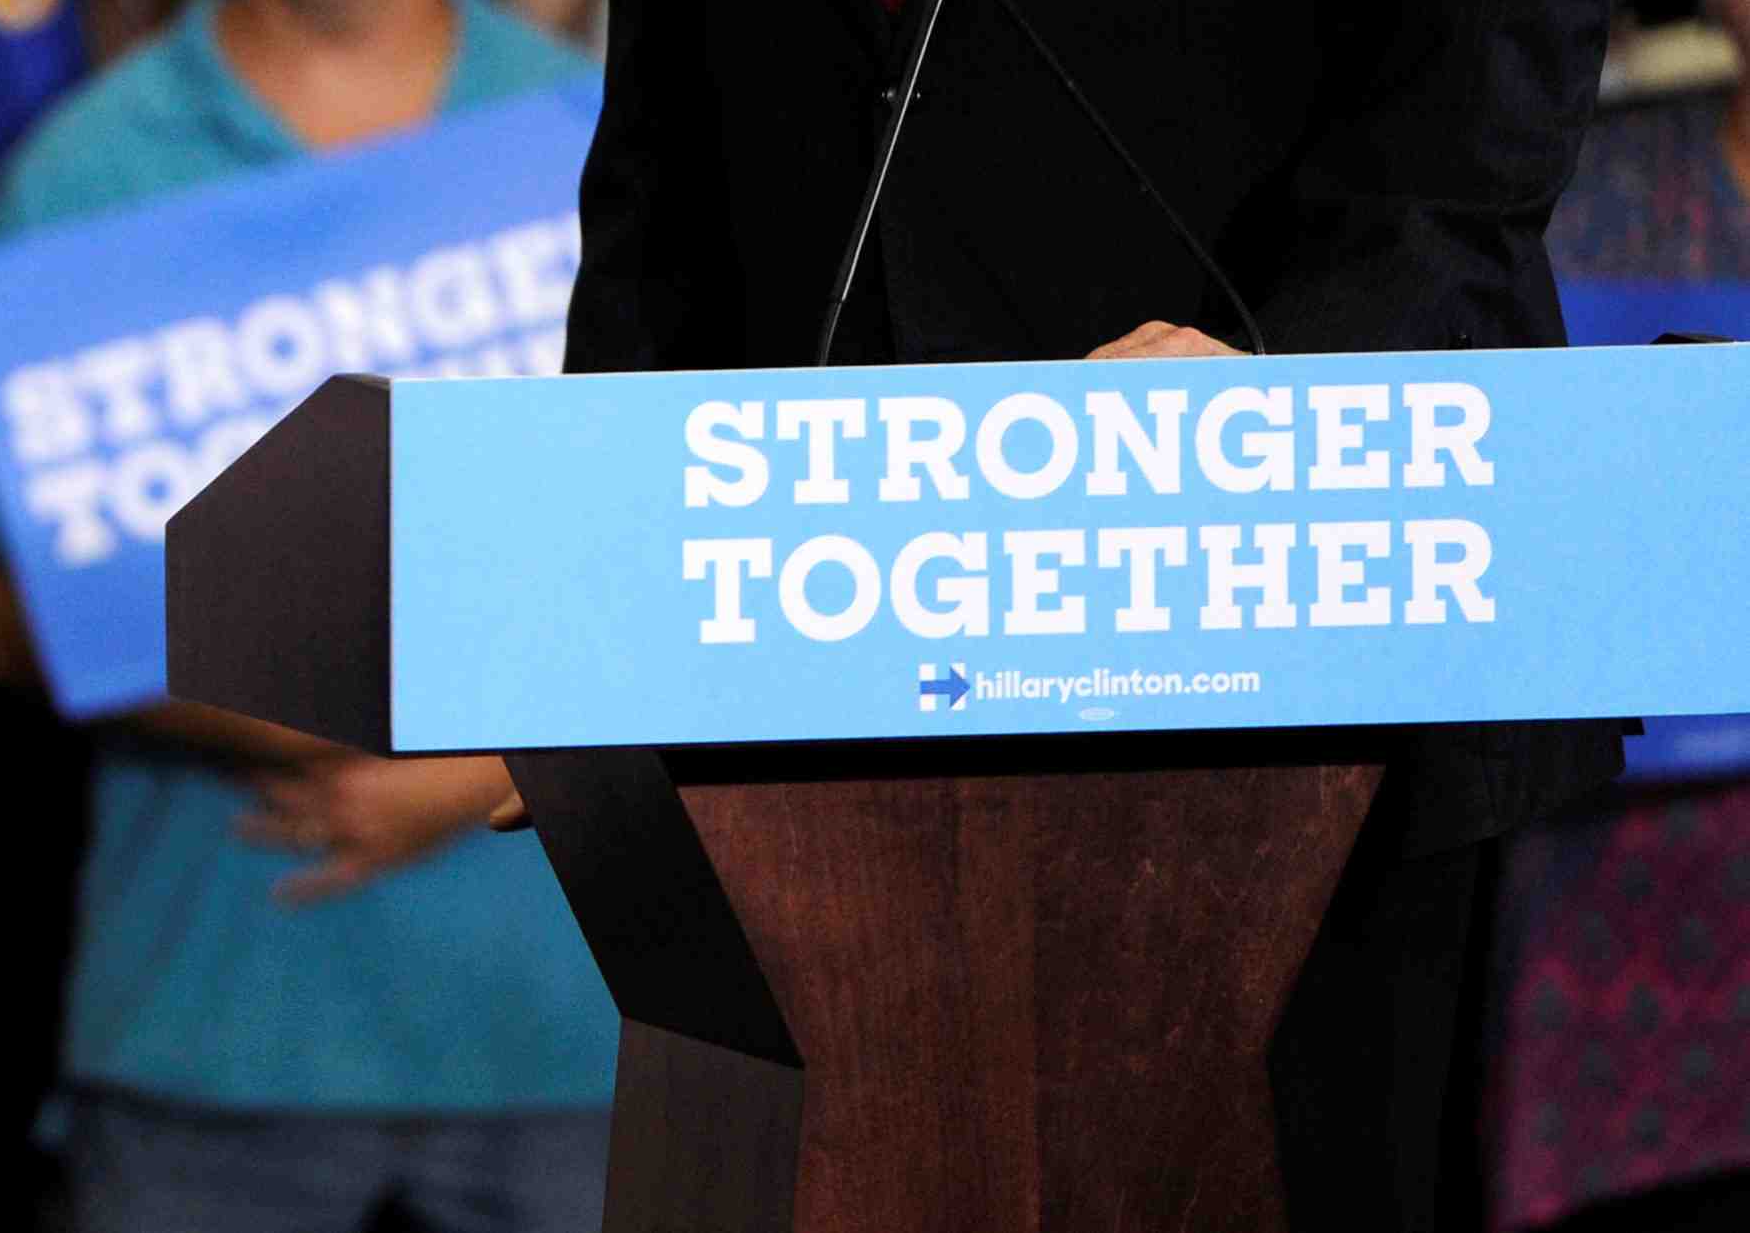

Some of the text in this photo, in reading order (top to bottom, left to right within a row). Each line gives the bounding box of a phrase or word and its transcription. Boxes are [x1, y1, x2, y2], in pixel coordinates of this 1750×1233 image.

[684, 382, 1495, 508] STRONGER
[682, 518, 1497, 644] TOGETHER
[975, 668, 1261, 704] hillaryclinton.com
